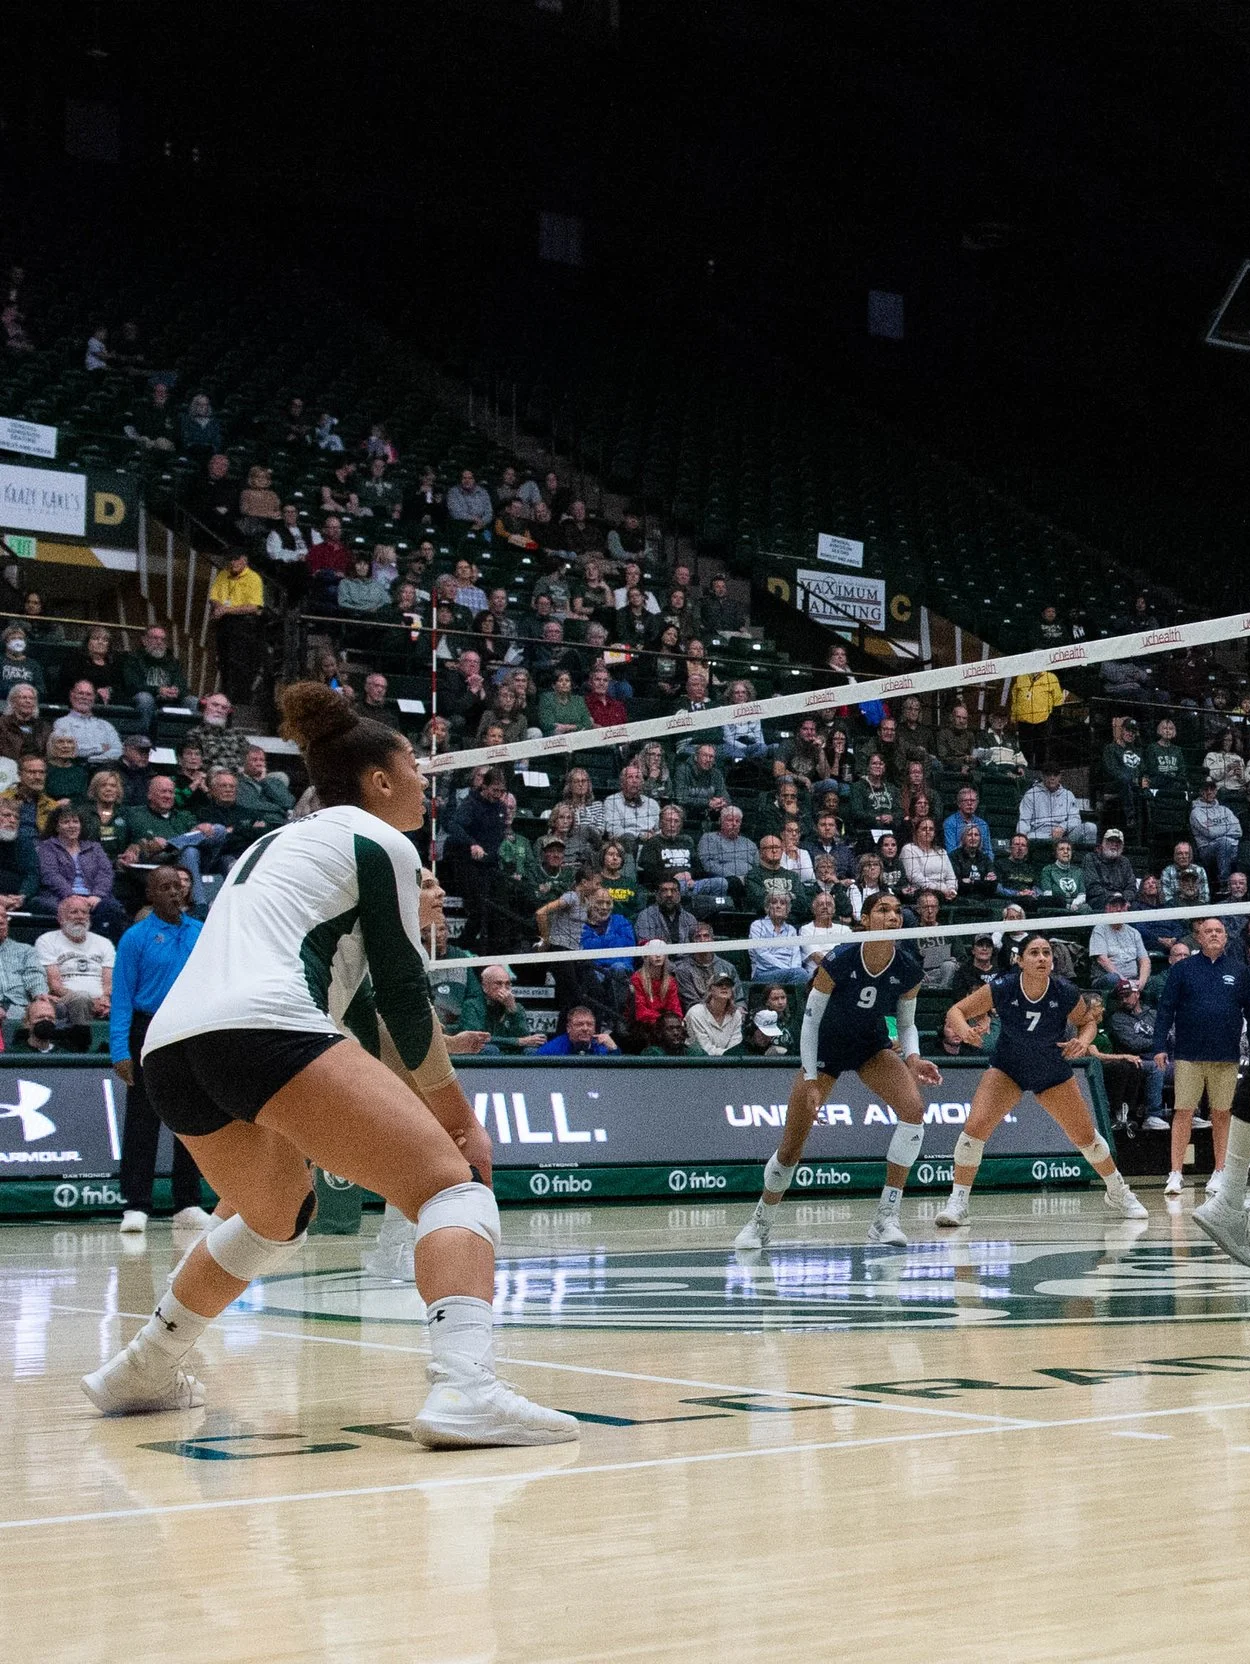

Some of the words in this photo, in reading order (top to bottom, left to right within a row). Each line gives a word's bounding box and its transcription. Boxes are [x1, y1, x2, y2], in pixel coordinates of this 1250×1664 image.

[94, 492, 126, 525] D
[800, 580, 878, 600] MAXIMUM
[810, 601, 882, 621] AINTING
[890, 594, 912, 622] C
[1142, 628, 1183, 648] uchealth
[1049, 646, 1086, 664] uchealth
[962, 662, 998, 679] uchealth
[880, 677, 914, 693] uchealth
[917, 936, 945, 950] CSU
[857, 986, 877, 1008] 9
[1025, 1011, 1041, 1032] 7
[863, 1102, 1018, 1125] AMO.
[815, 1168, 851, 1185] fnbo
[936, 1164, 954, 1181] fnb
[1050, 1162, 1081, 1178] fnbo
[552, 1175, 592, 1193] fnbo
[689, 1171, 727, 1189] fnbo
